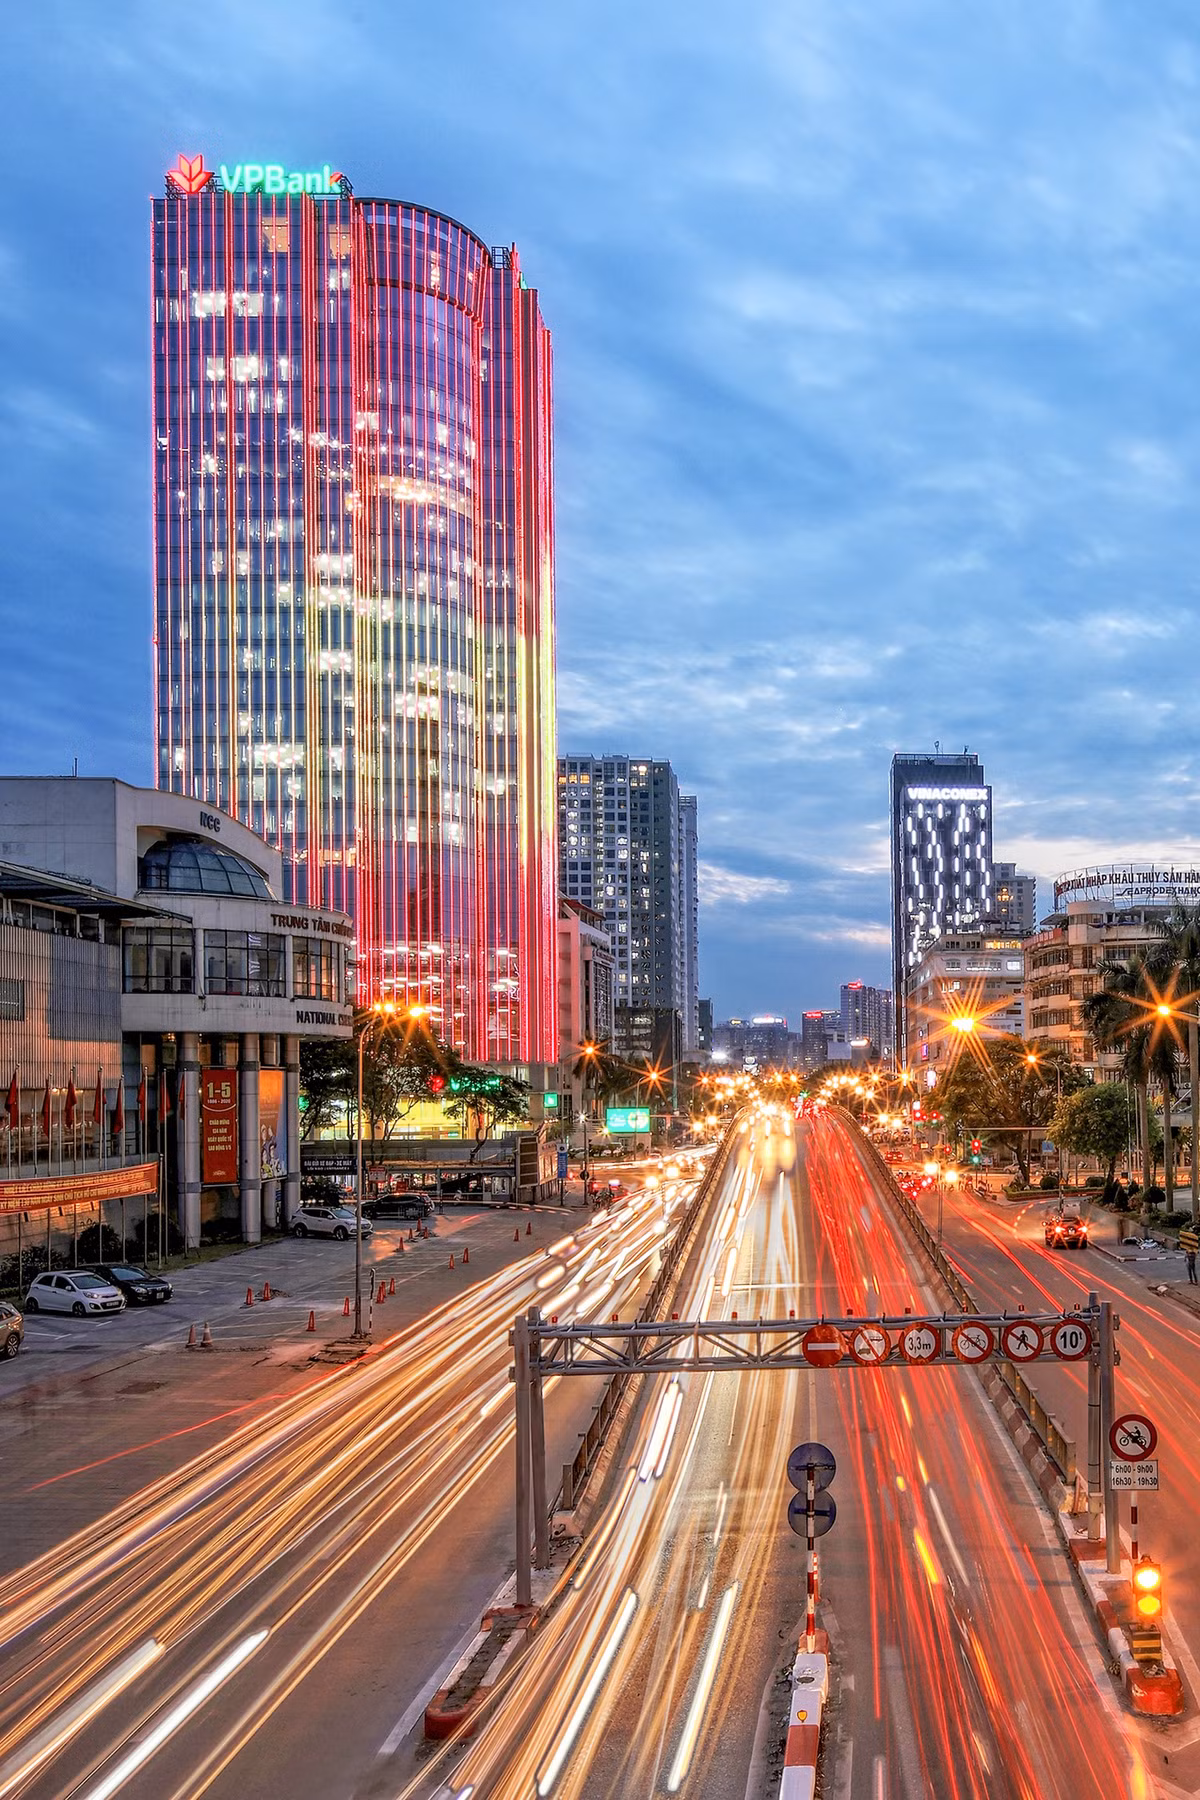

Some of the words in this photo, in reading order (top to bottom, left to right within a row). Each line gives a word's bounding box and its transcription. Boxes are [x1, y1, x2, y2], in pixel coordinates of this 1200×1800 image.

[219, 163, 342, 194] VPBank
[907, 787, 988, 801] VINACONEX
[200, 811, 221, 833] NCC
[270, 913, 309, 930] TRUNG
[311, 916, 331, 933] TÂM
[296, 1010, 337, 1025] NATIONAL
[207, 1082, 231, 1099] 1-5
[908, 1337, 931, 1354] 3,3m
[1115, 1464, 1132, 1474] 6h00
[1136, 1464, 1154, 1474] 9h00
[1112, 1476, 1132, 1486] 16h30
[1137, 1476, 1158, 1486] 19h30
